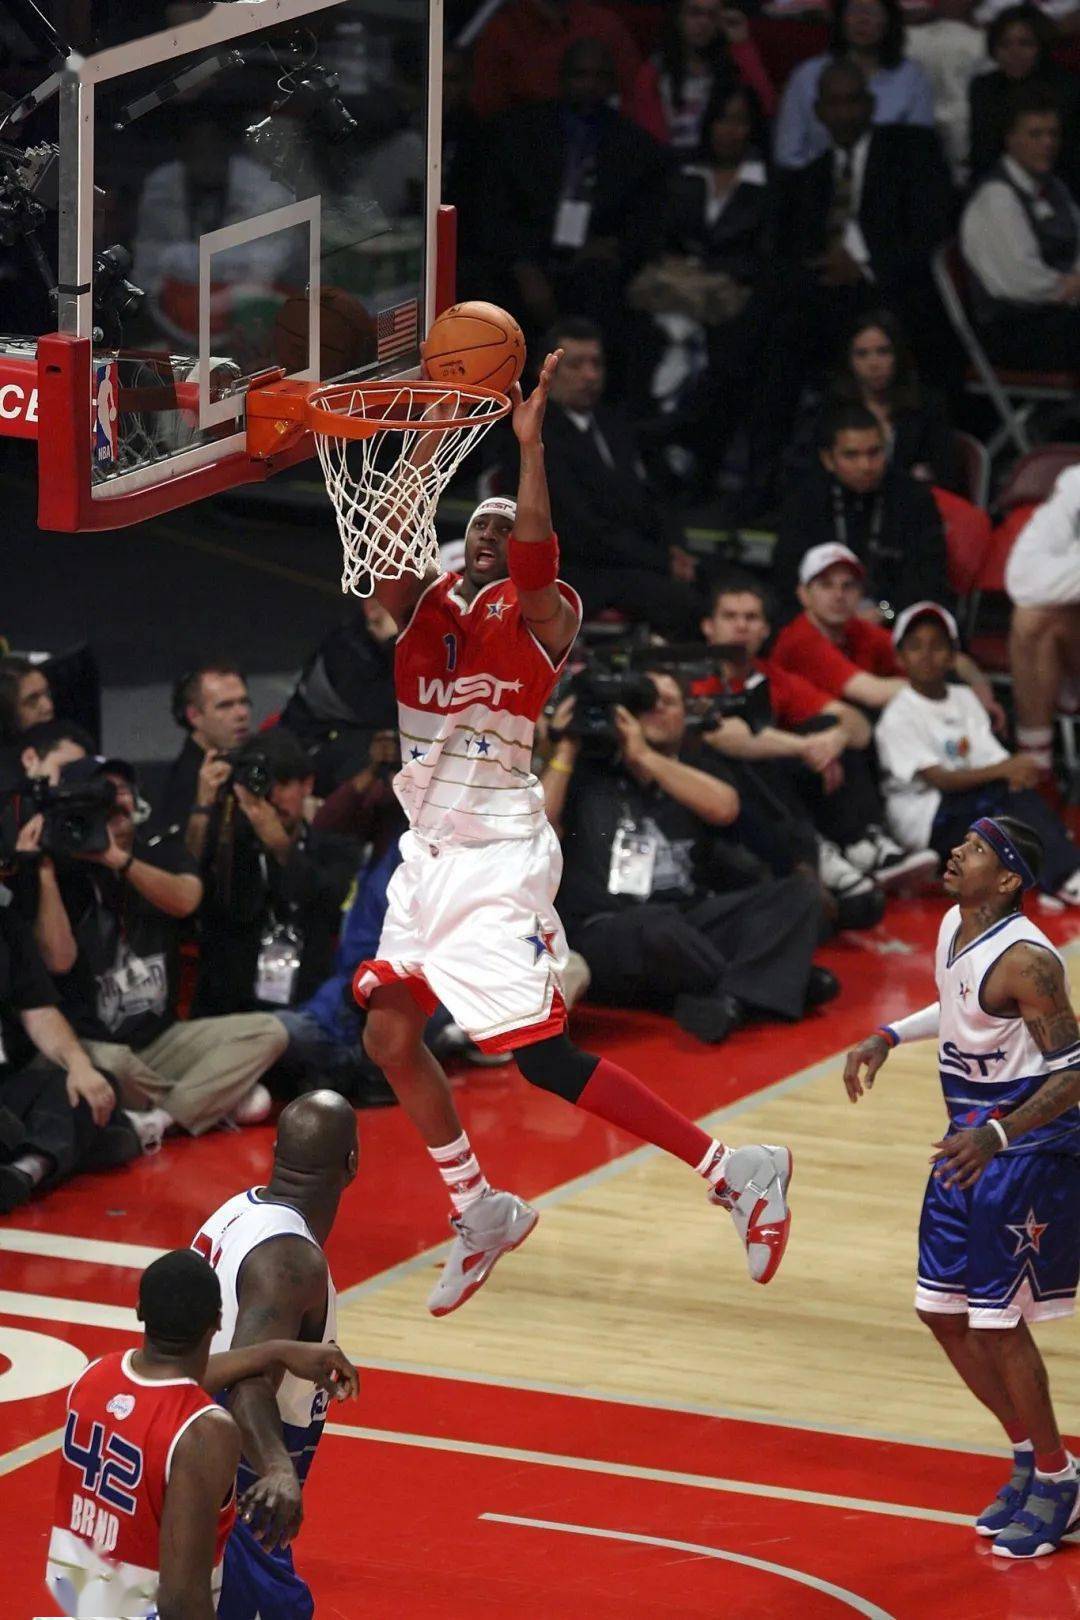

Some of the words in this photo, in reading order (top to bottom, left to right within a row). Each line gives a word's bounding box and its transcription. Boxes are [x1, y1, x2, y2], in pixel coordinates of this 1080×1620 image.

[443, 632, 457, 671] 1
[939, 1042, 1008, 1077] ST
[63, 1410, 143, 1516] 42
